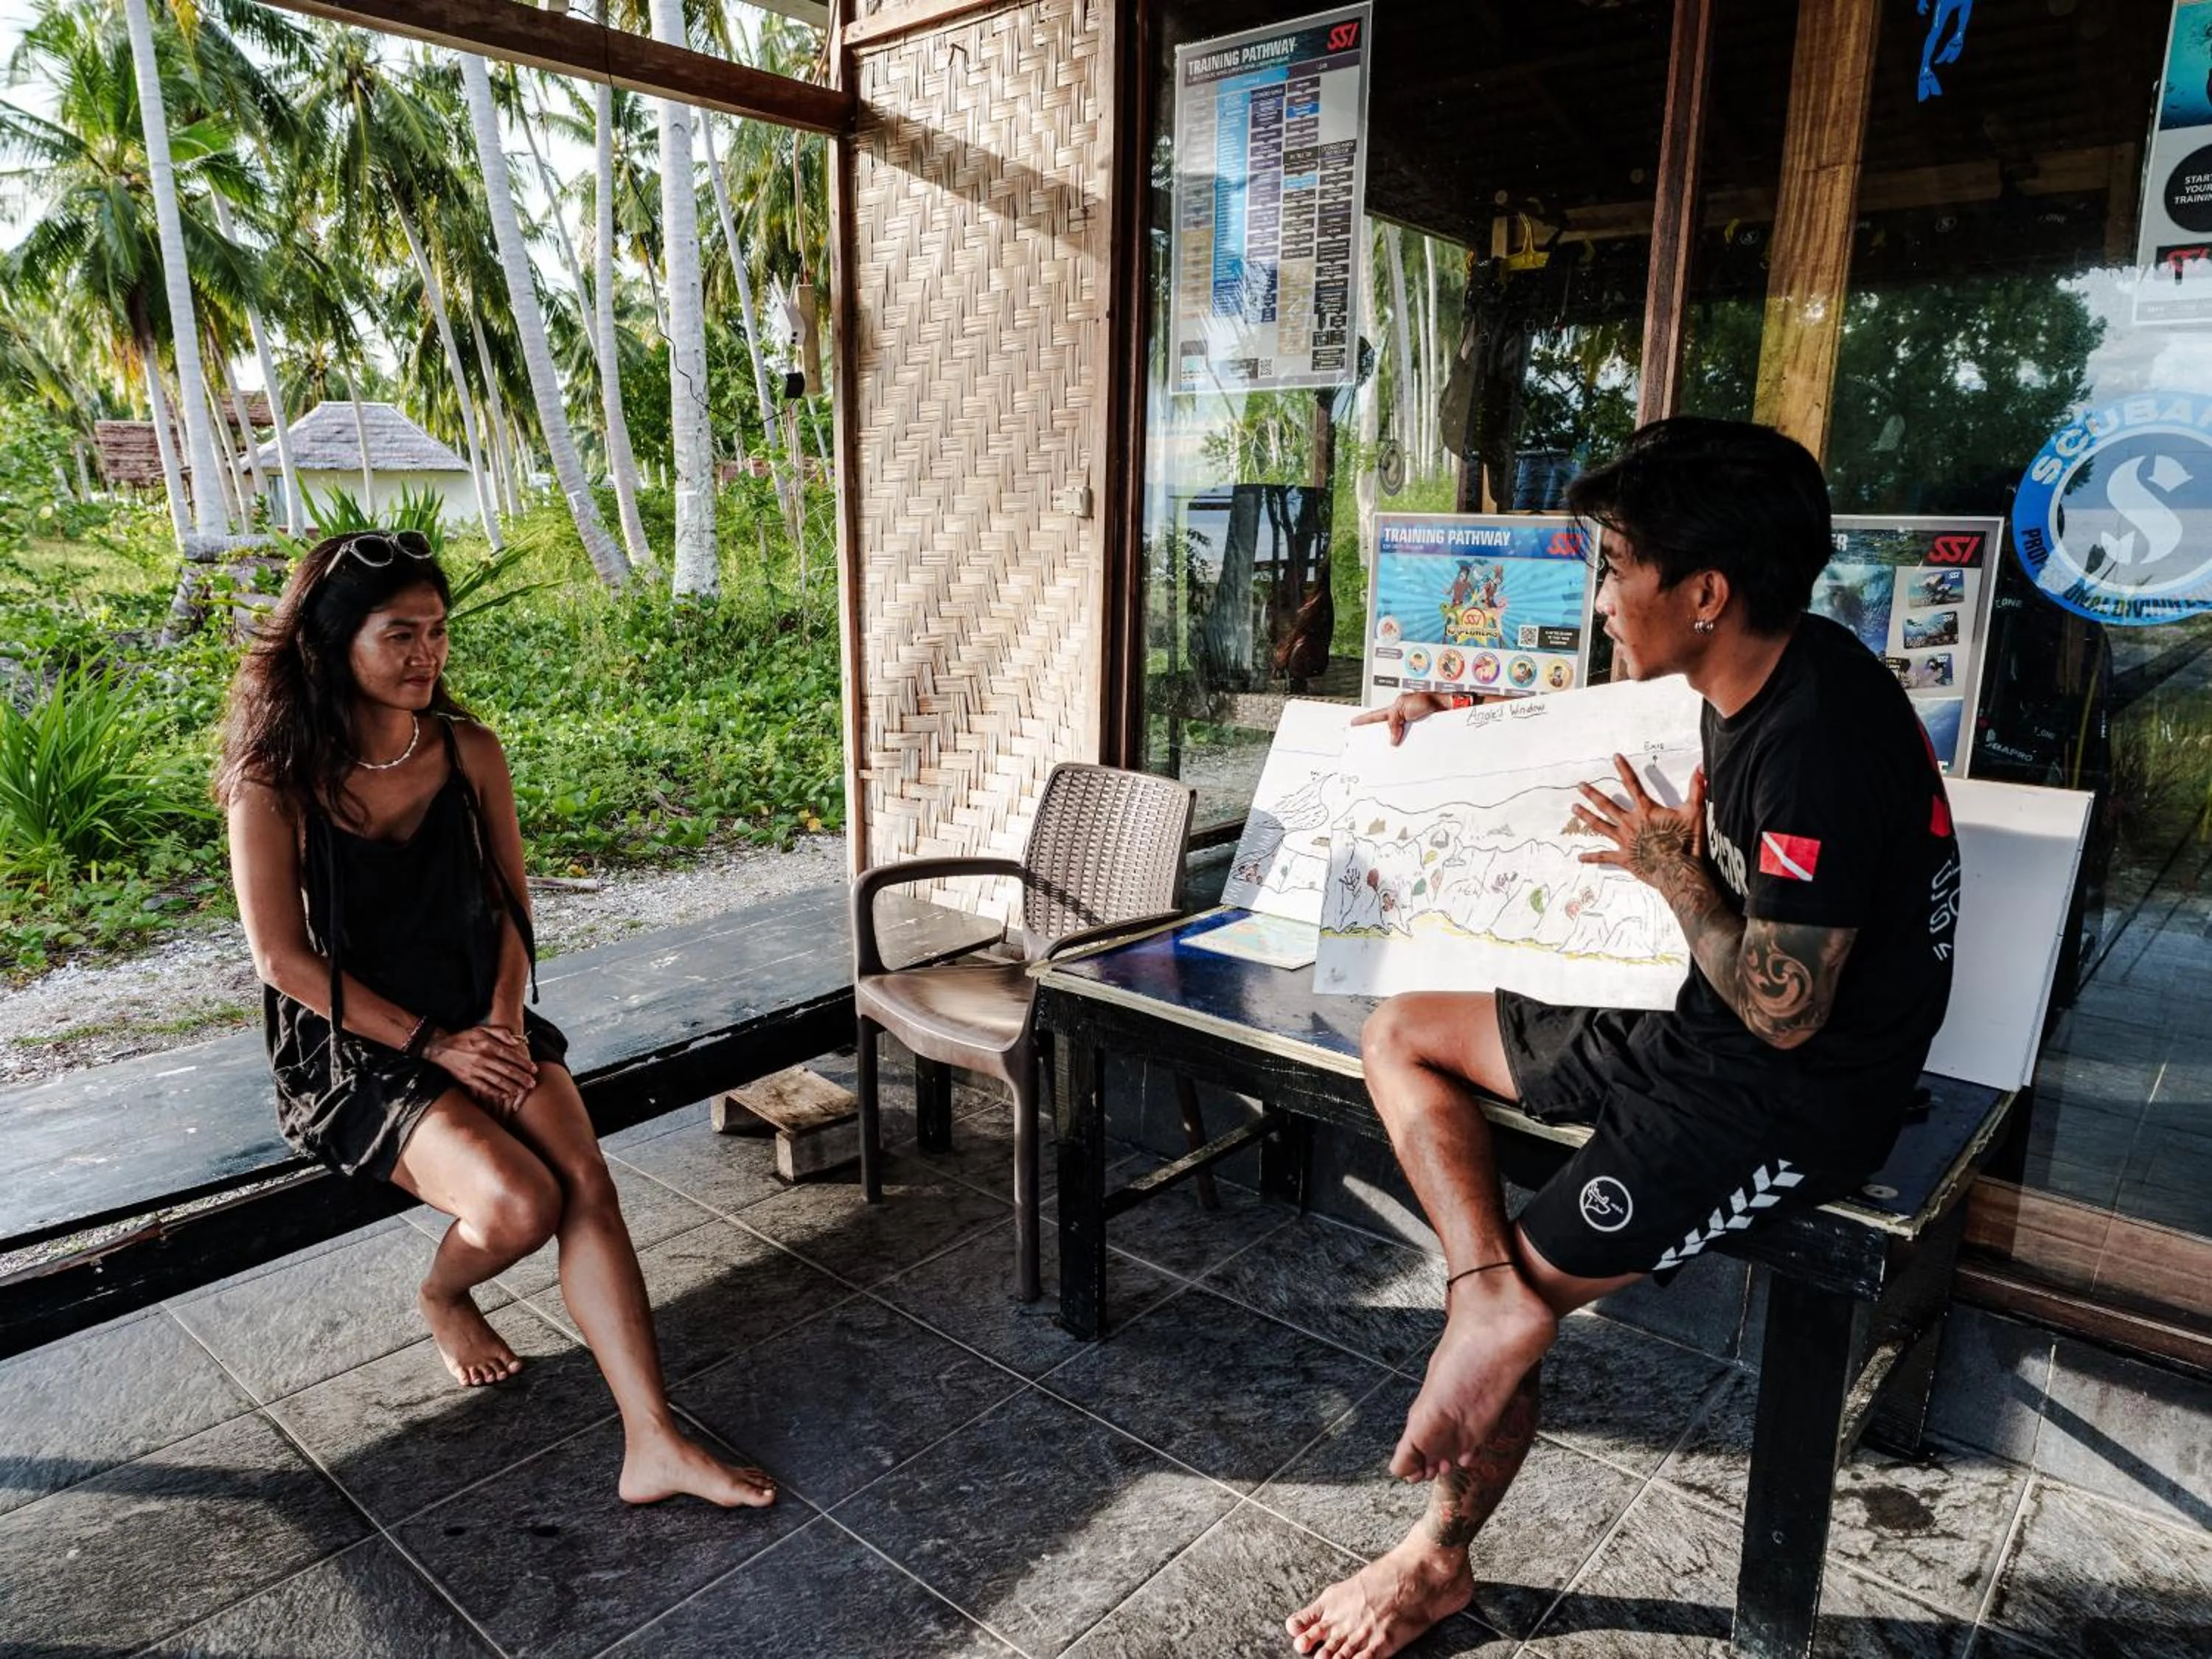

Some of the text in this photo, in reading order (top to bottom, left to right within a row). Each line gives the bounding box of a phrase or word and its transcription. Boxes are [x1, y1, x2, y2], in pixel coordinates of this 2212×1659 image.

[1326, 22, 1359, 51] SSI
[1188, 51, 1240, 76] TRAINING
[1242, 36, 1296, 66] PATHWAY
[1383, 526, 1511, 547] TRAINING PATHWAY
[1927, 535, 1982, 564] SSI
